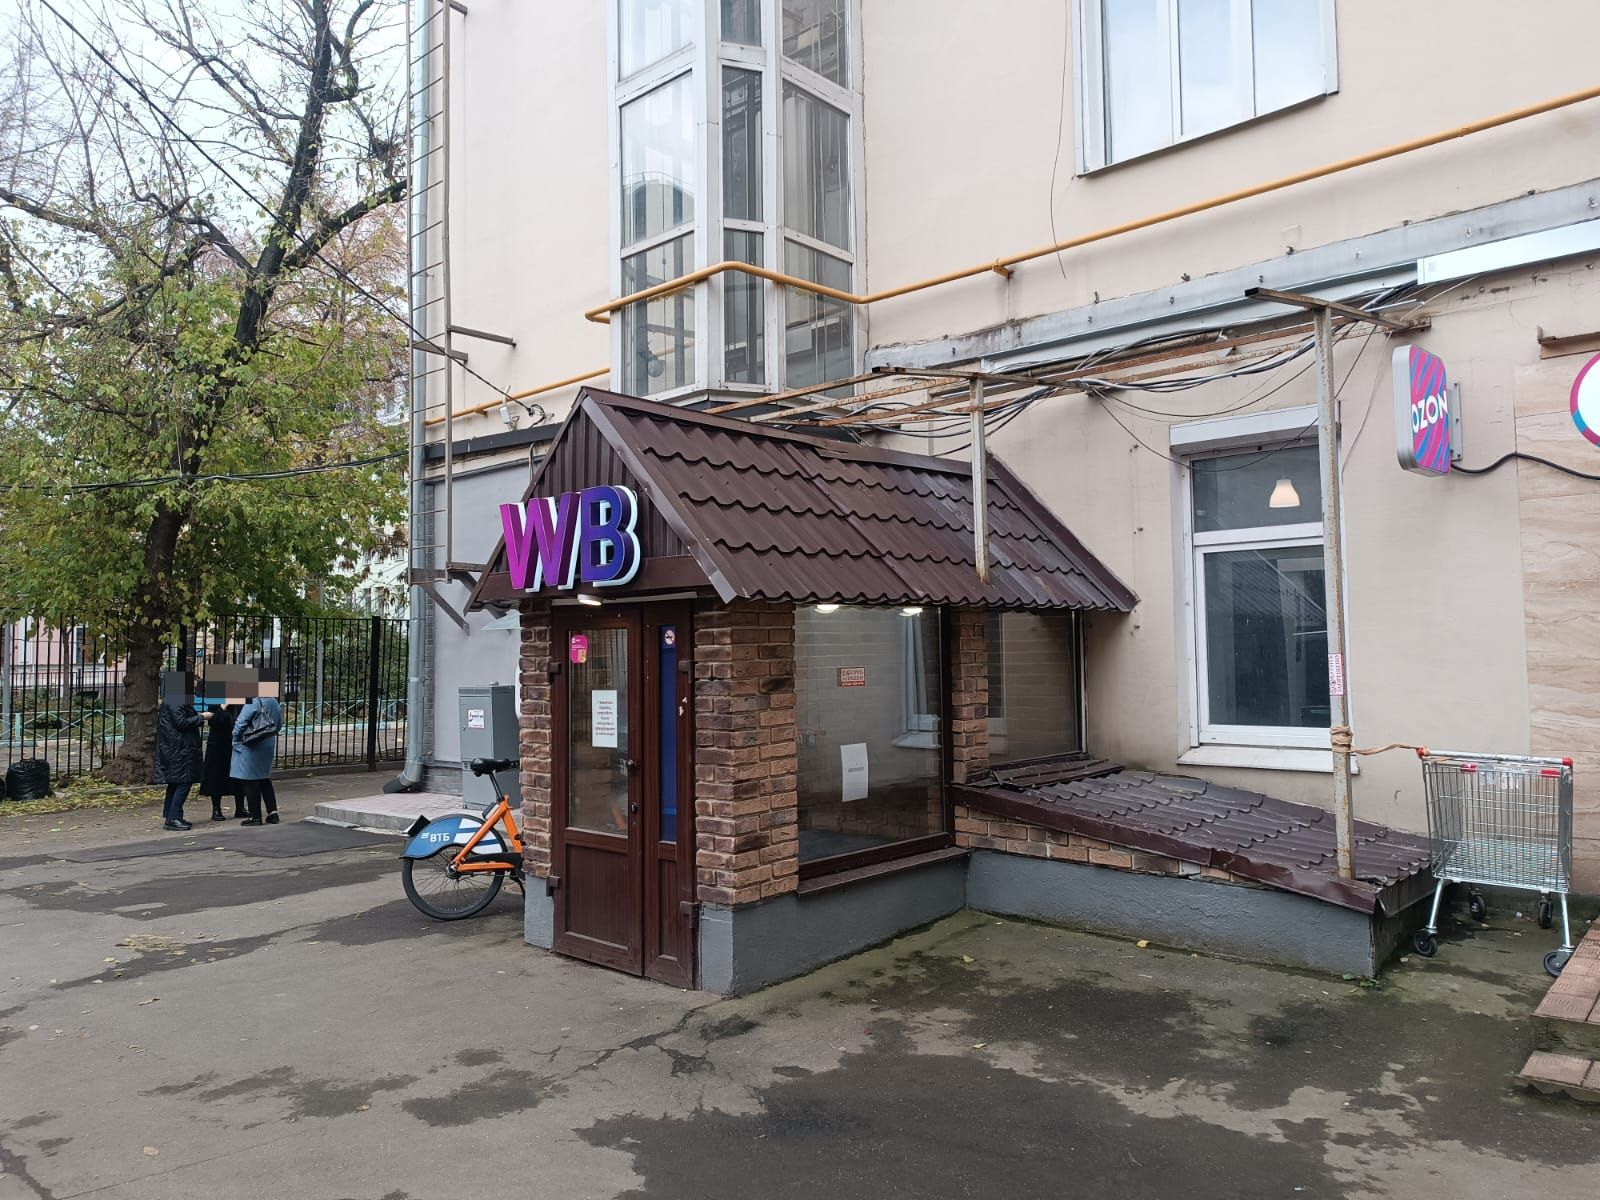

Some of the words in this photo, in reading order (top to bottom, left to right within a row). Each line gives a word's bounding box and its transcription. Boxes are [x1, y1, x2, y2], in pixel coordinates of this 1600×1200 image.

[1411, 390, 1448, 433] OZON
[499, 485, 640, 592] WB
[430, 832, 450, 842] ВТБ
